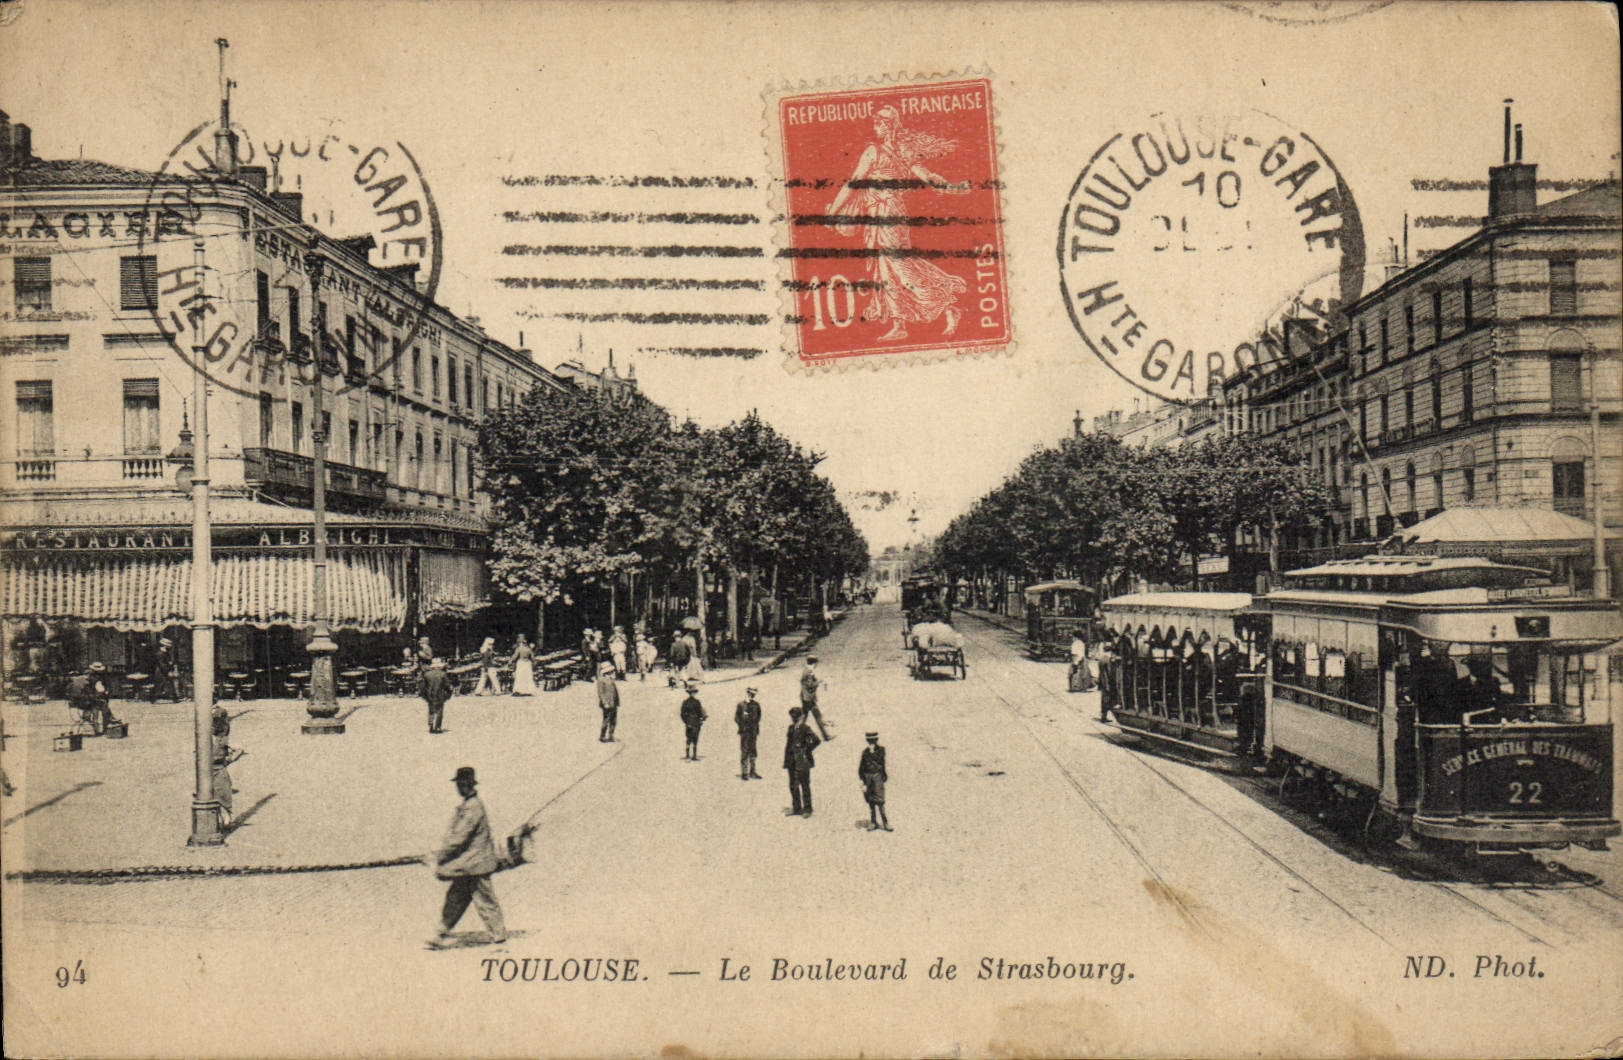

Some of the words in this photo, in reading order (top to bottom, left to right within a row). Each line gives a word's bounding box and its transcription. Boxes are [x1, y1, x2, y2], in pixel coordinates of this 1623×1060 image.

[901, 92, 983, 115] FRANÇAISE
[976, 243, 999, 328] POSTES
[1509, 781, 1543, 804] 22
